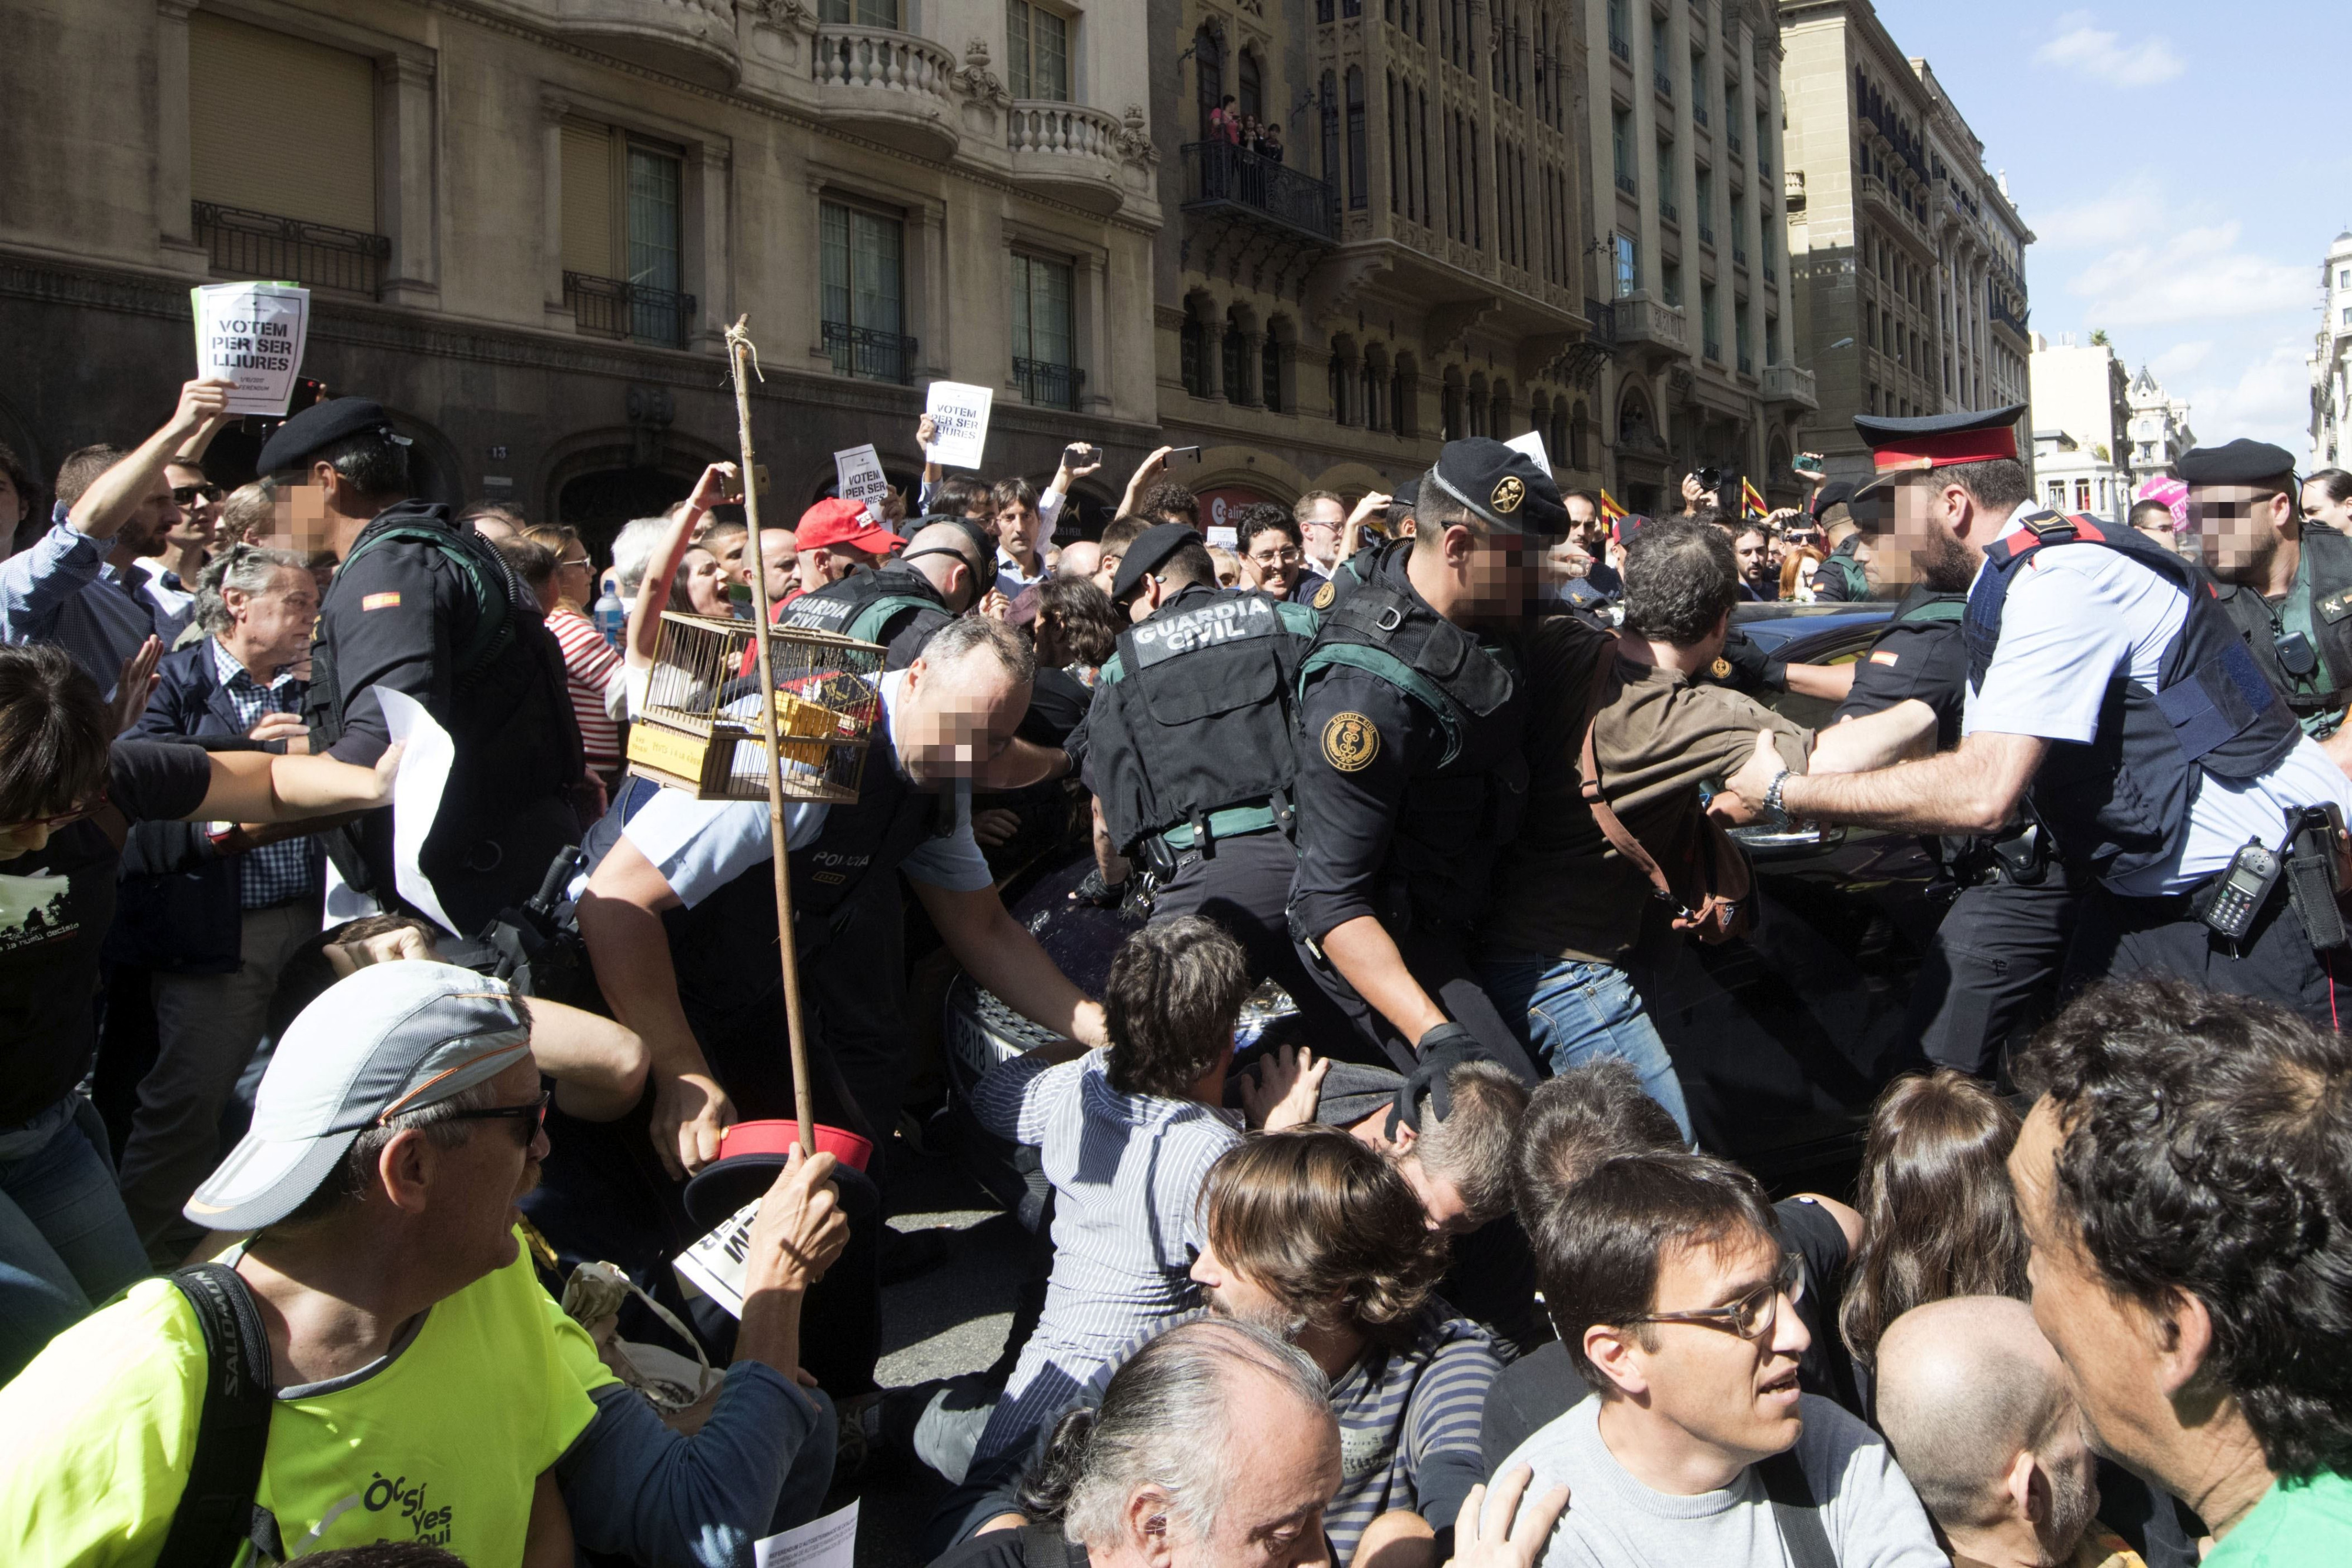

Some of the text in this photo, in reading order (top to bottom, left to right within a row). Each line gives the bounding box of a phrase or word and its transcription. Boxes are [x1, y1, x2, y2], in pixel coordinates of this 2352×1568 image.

[219, 320, 288, 337] VOTEM
[212, 337, 292, 355] PER SER
[213, 354, 289, 371] LLIURES
[937, 404, 976, 418] VOTEM
[956, 418, 978, 429] SER
[493, 447, 506, 458] 13
[849, 469, 881, 486] VOTEM
[846, 481, 886, 499] PER SER
[788, 597, 852, 618] GUARDIA
[789, 612, 824, 630] CIVIL
[1135, 598, 1269, 644] GUARDIA
[1167, 618, 1245, 650] CIVIL
[1332, 714, 1376, 734] GUARDIA CIVIL
[958, 1017, 985, 1071] 3818
[187, 1271, 238, 1398] SALOMON
[364, 1471, 406, 1512] Òc
